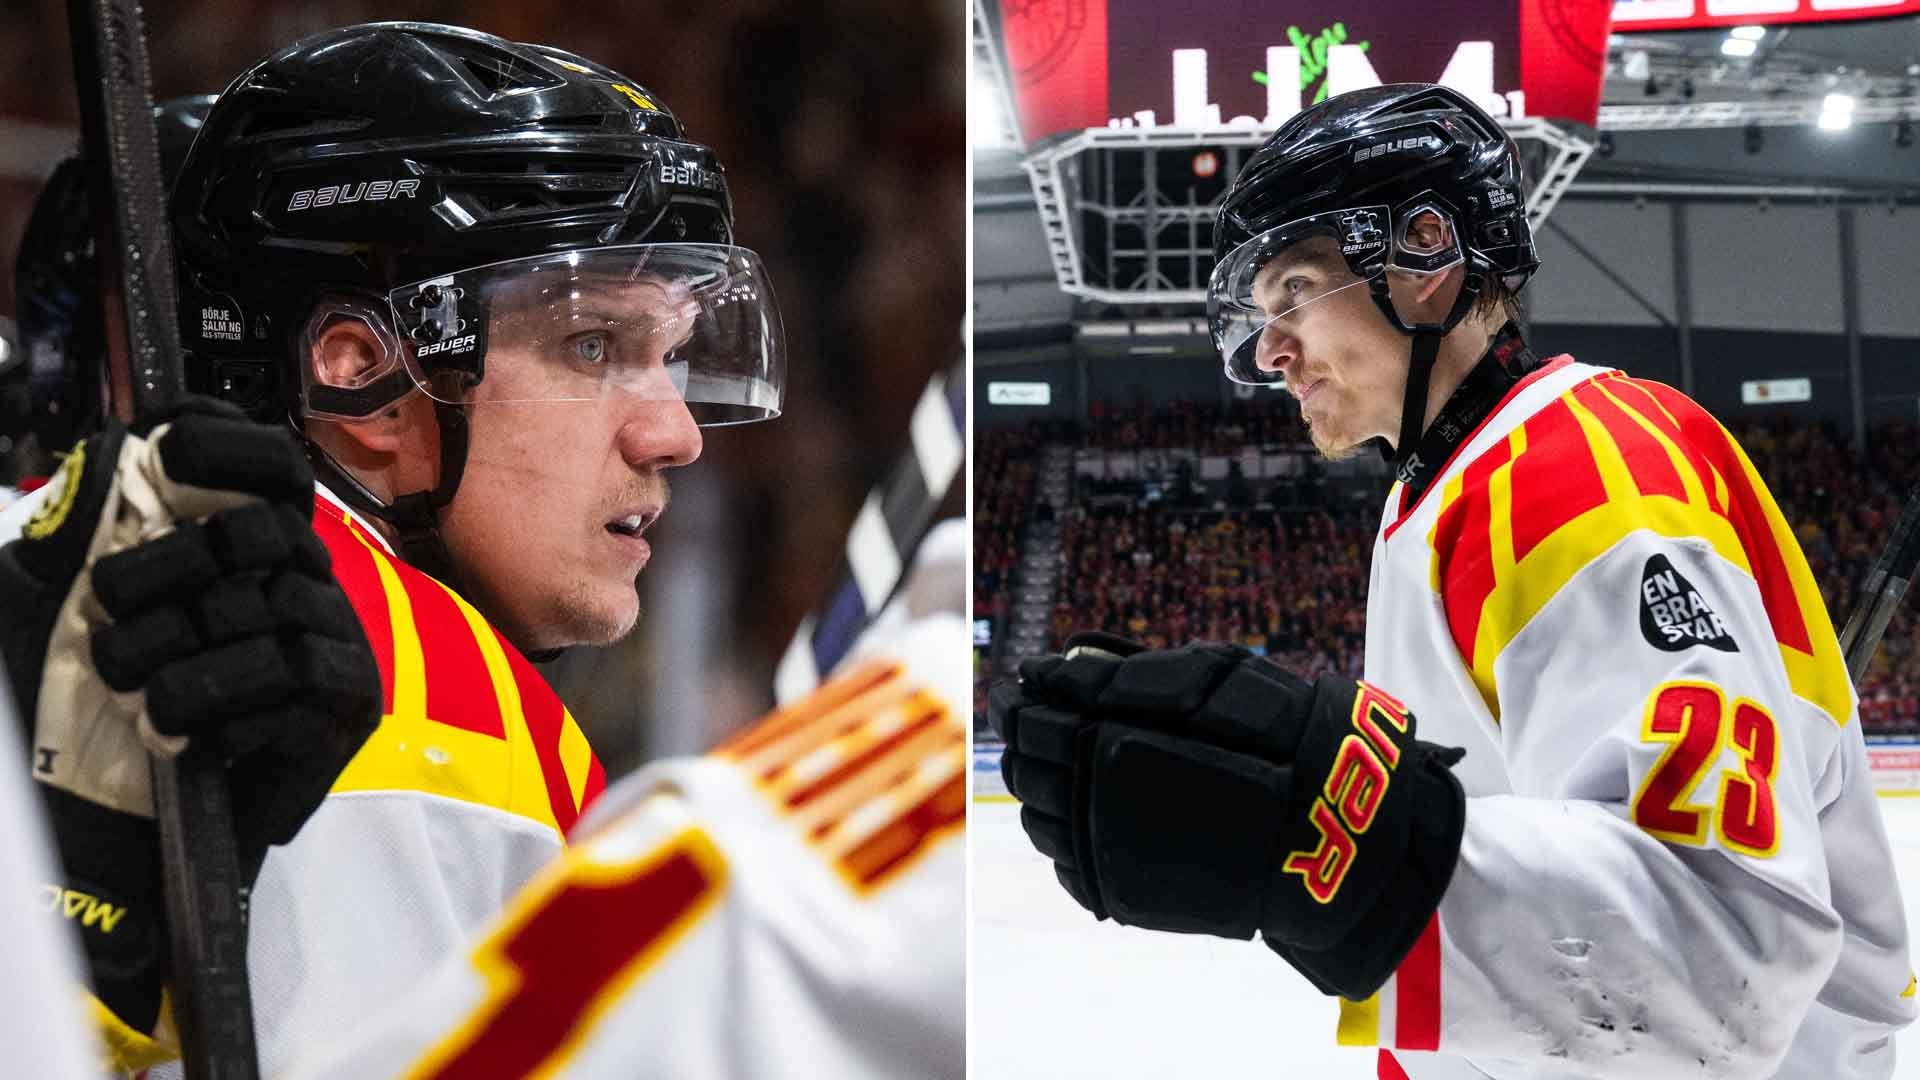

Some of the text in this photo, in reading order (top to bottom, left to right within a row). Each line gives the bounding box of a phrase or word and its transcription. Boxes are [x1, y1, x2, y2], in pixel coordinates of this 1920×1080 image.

[1354, 136, 1433, 163] BAUER
[288, 179, 420, 211] BAUER
[1343, 240, 1382, 253] BAUER
[202, 306, 230, 320] BÖRJE
[417, 334, 476, 357] BAUER
[1643, 569, 1680, 606] EN
[1631, 679, 1781, 859] 23
